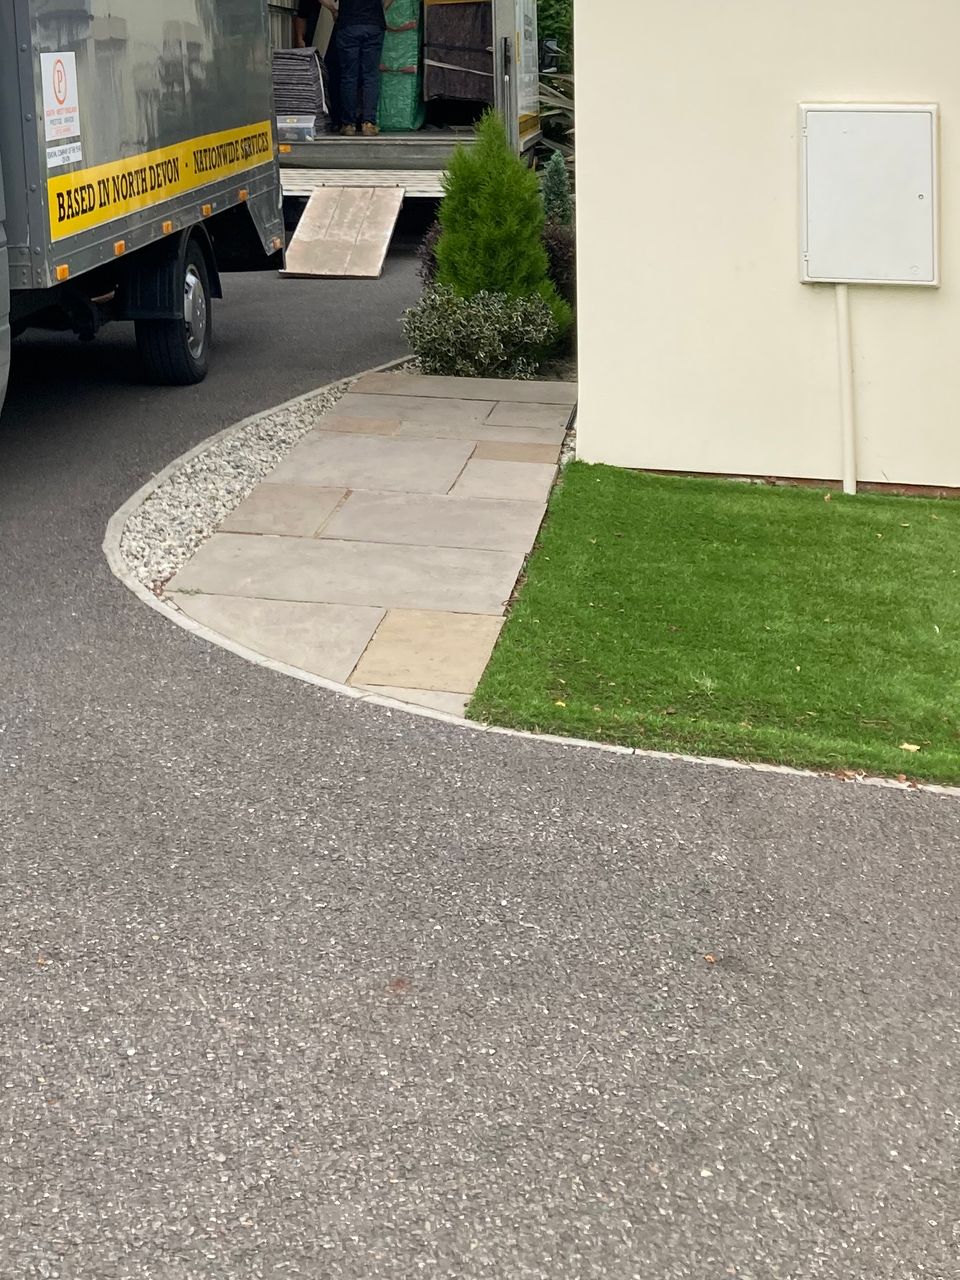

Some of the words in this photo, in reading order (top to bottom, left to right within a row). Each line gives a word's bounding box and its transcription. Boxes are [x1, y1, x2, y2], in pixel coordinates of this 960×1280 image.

[56, 183, 96, 223] BASED
[97, 177, 110, 209] IN
[112, 167, 148, 204] NORTH
[149, 157, 180, 192] DEVON
[193, 139, 239, 175] NATIONWIDE
[240, 130, 269, 161] SERVICES
